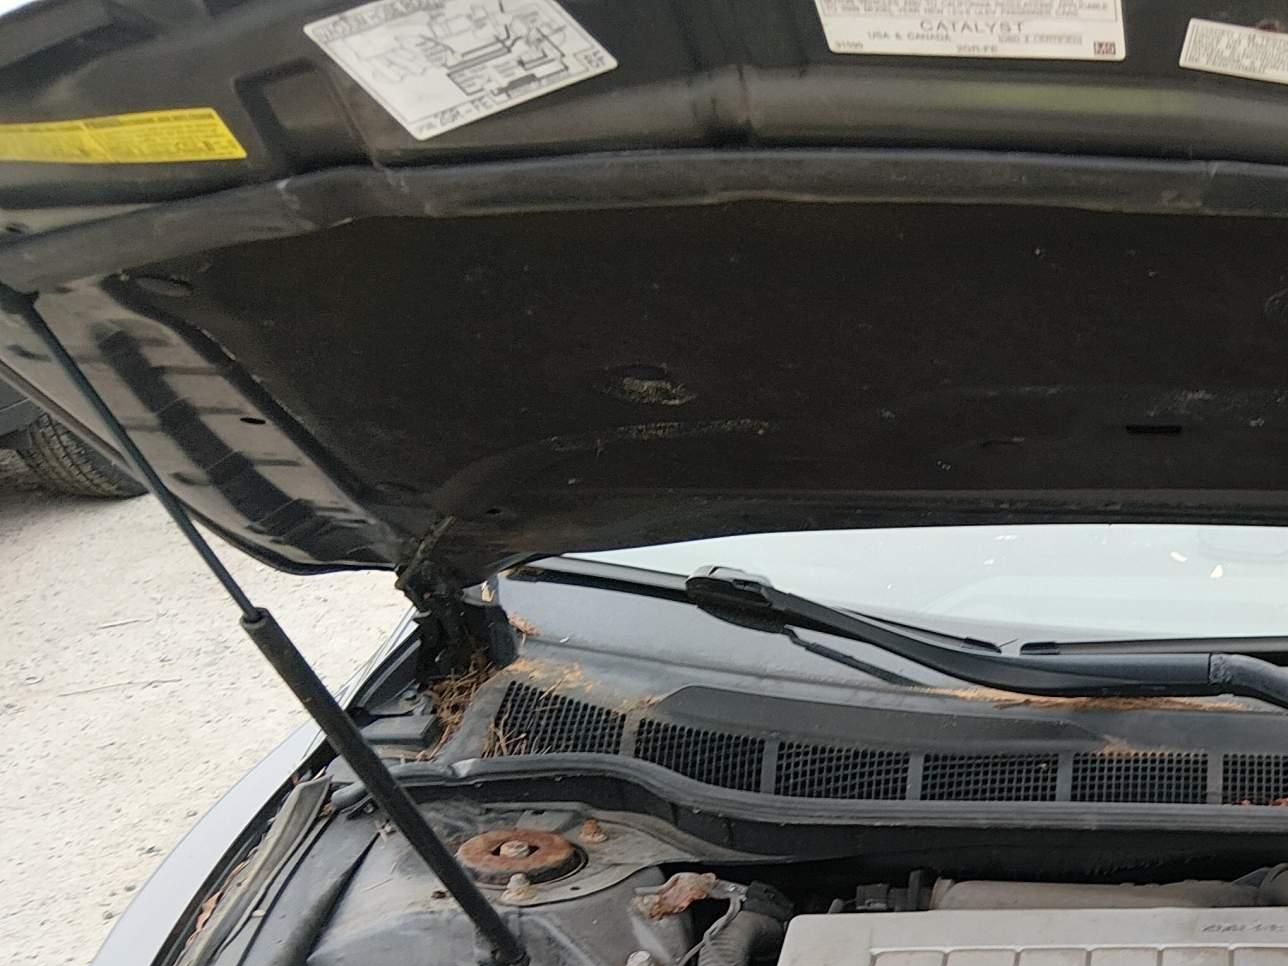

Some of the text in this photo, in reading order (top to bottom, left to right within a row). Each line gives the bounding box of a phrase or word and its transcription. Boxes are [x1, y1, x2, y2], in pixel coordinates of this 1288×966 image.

[919, 20, 1024, 33] CATALYST
[867, 31, 890, 41] USA
[907, 31, 952, 42] CANADA
